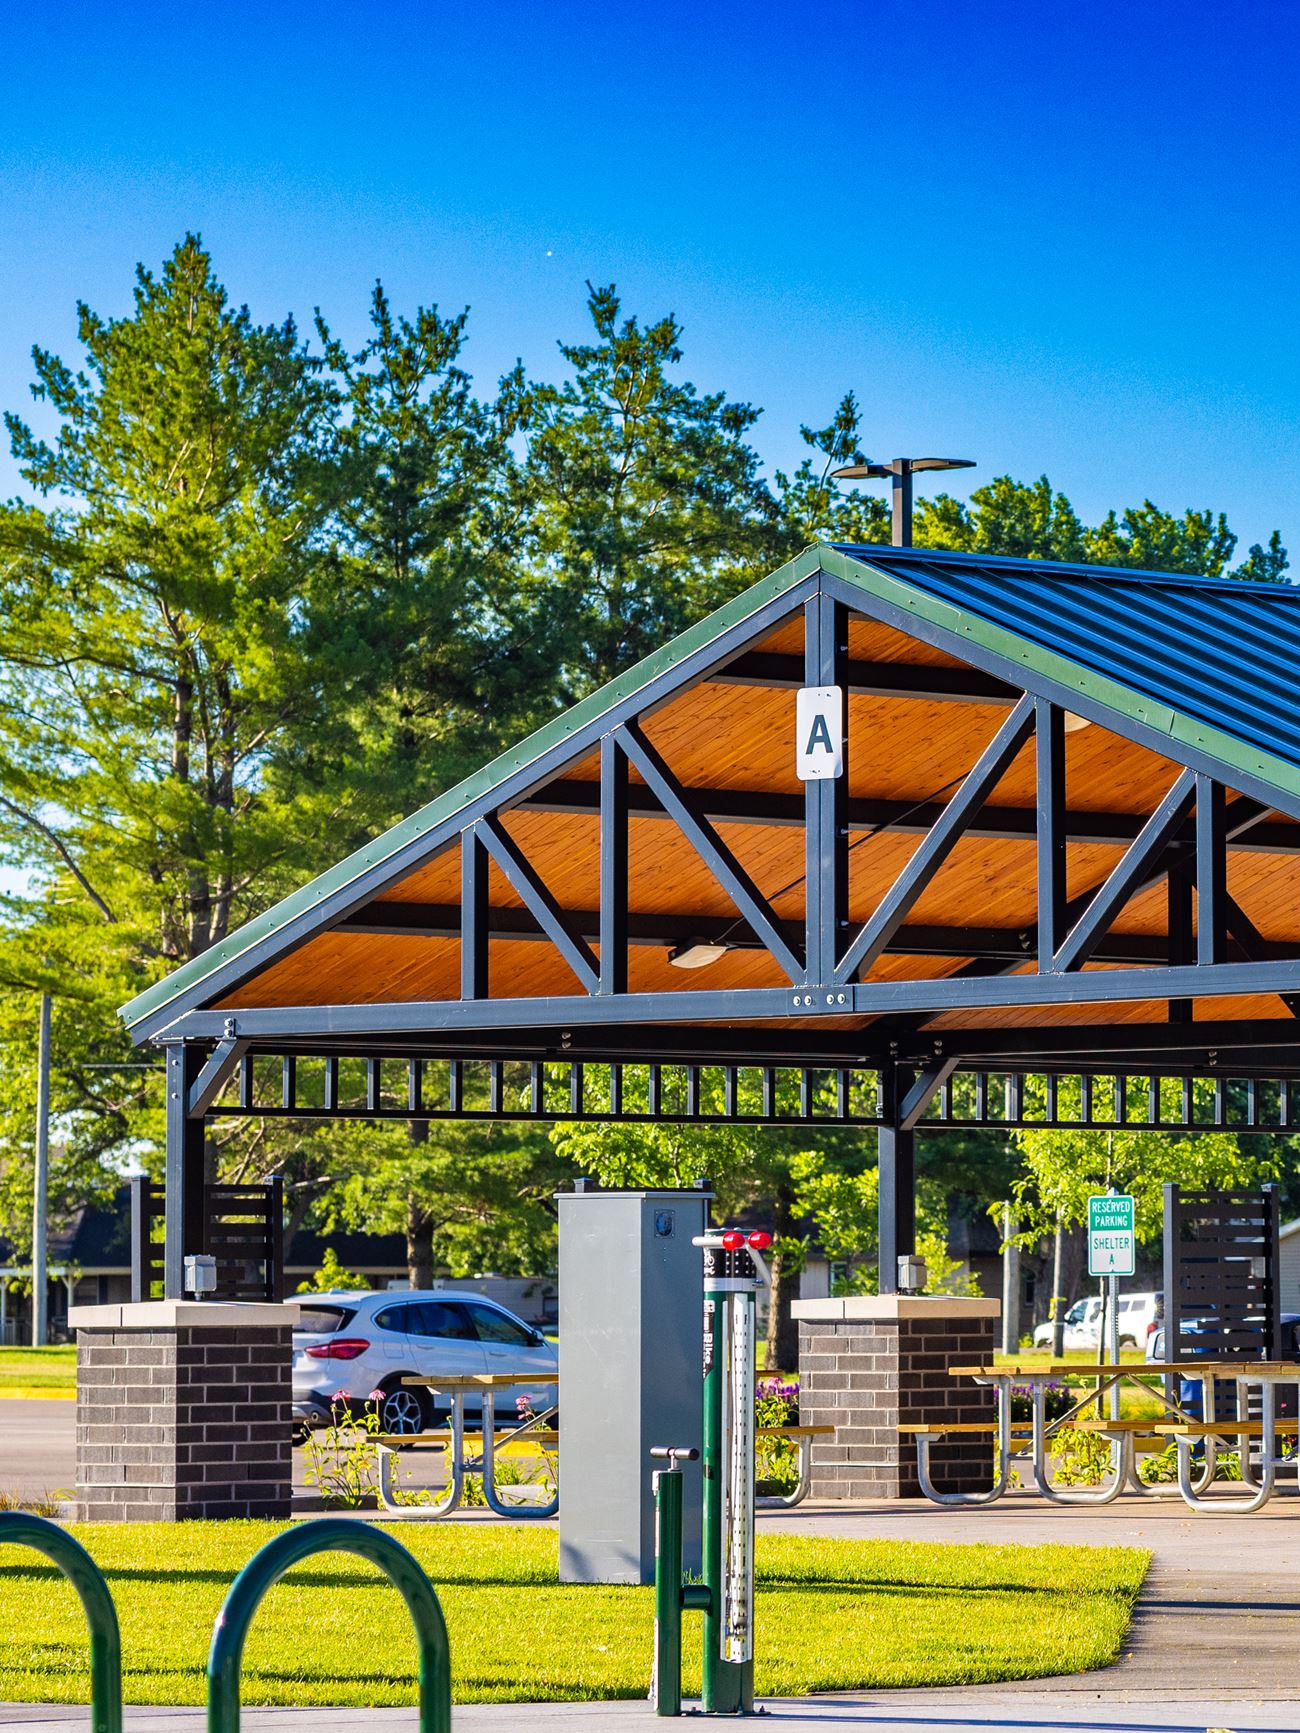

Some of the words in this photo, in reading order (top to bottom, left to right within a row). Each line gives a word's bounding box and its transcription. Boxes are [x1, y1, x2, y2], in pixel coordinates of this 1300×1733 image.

[805, 714, 834, 755] A
[1091, 1201, 1131, 1213] RESERVED
[1095, 1215, 1128, 1227] PARKING
[1093, 1237, 1130, 1249] SHELTER
[1109, 1254, 1115, 1264] A
